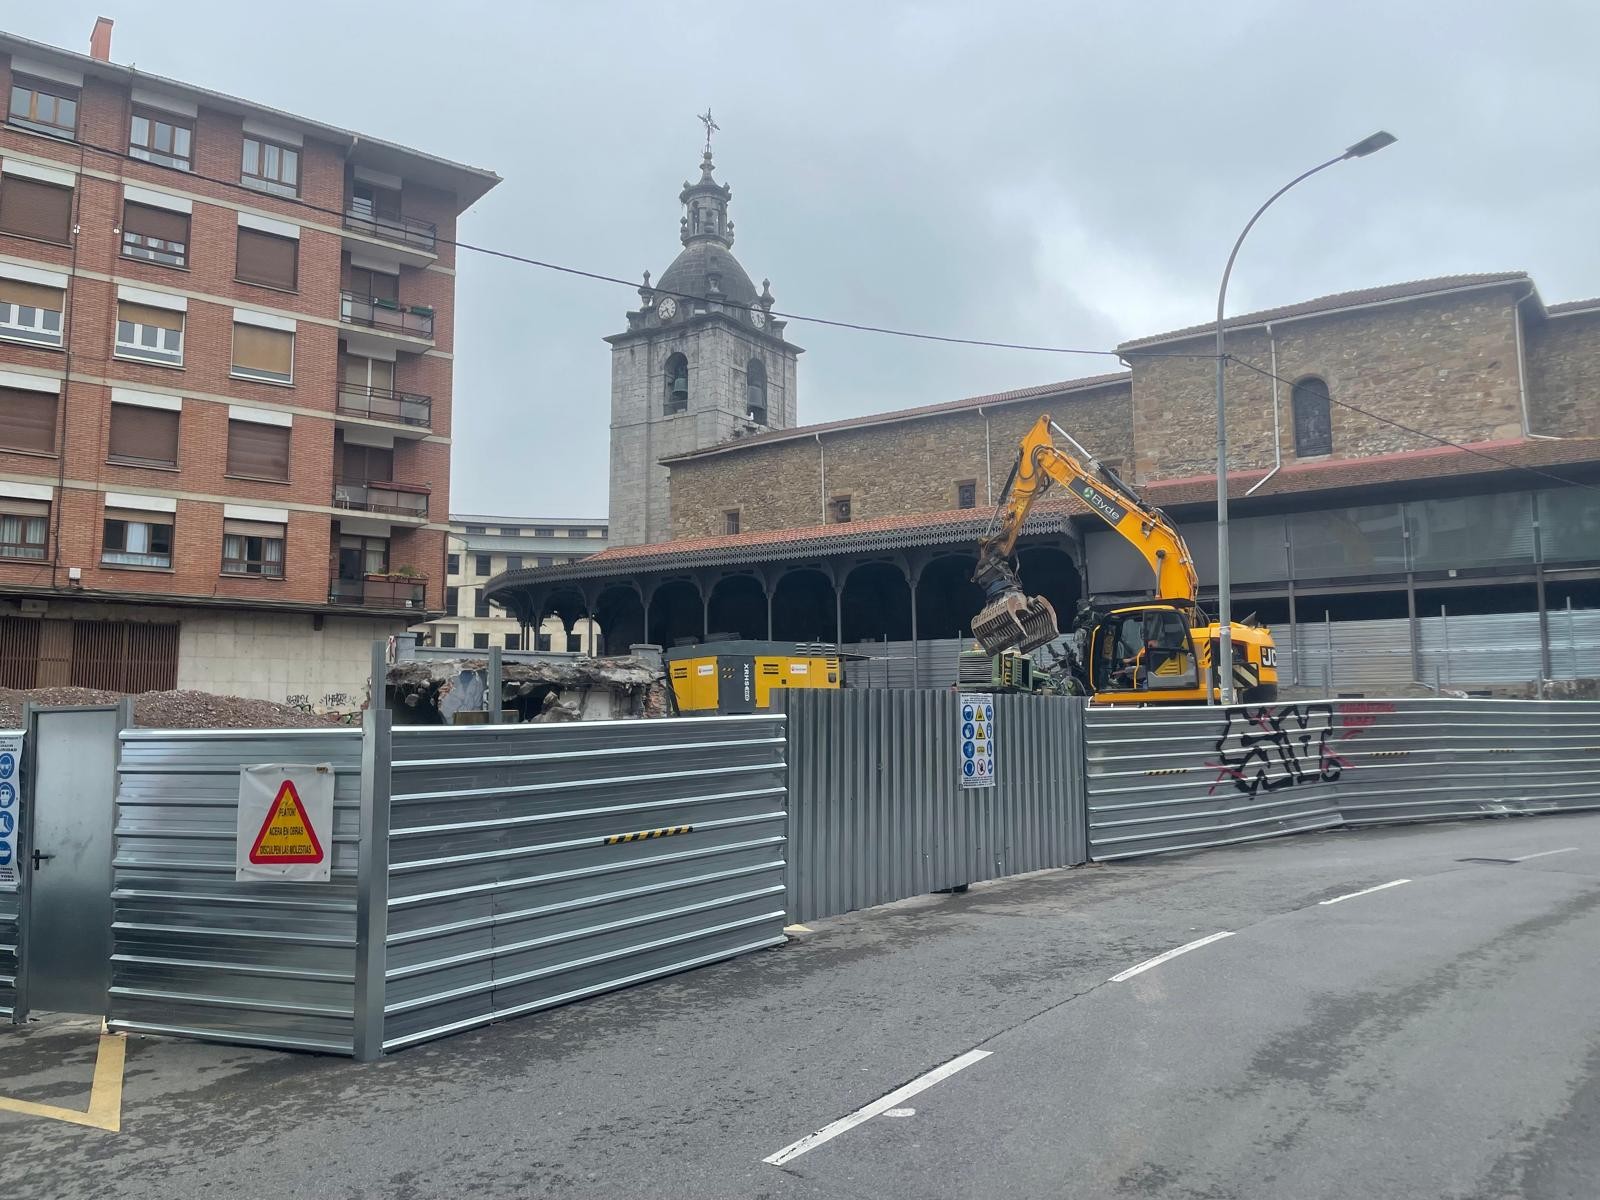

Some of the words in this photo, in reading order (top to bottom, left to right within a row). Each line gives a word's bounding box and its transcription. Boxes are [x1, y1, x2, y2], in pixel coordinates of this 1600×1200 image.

[1262, 648, 1278, 667] JC
[269, 826, 282, 836] ACERA
[283, 826, 289, 836] EN
[290, 826, 304, 836] OBRAS
[260, 845, 281, 855] DISCULPEN
[281, 845, 289, 855] LAS
[290, 845, 311, 854] MOLESTIAS
